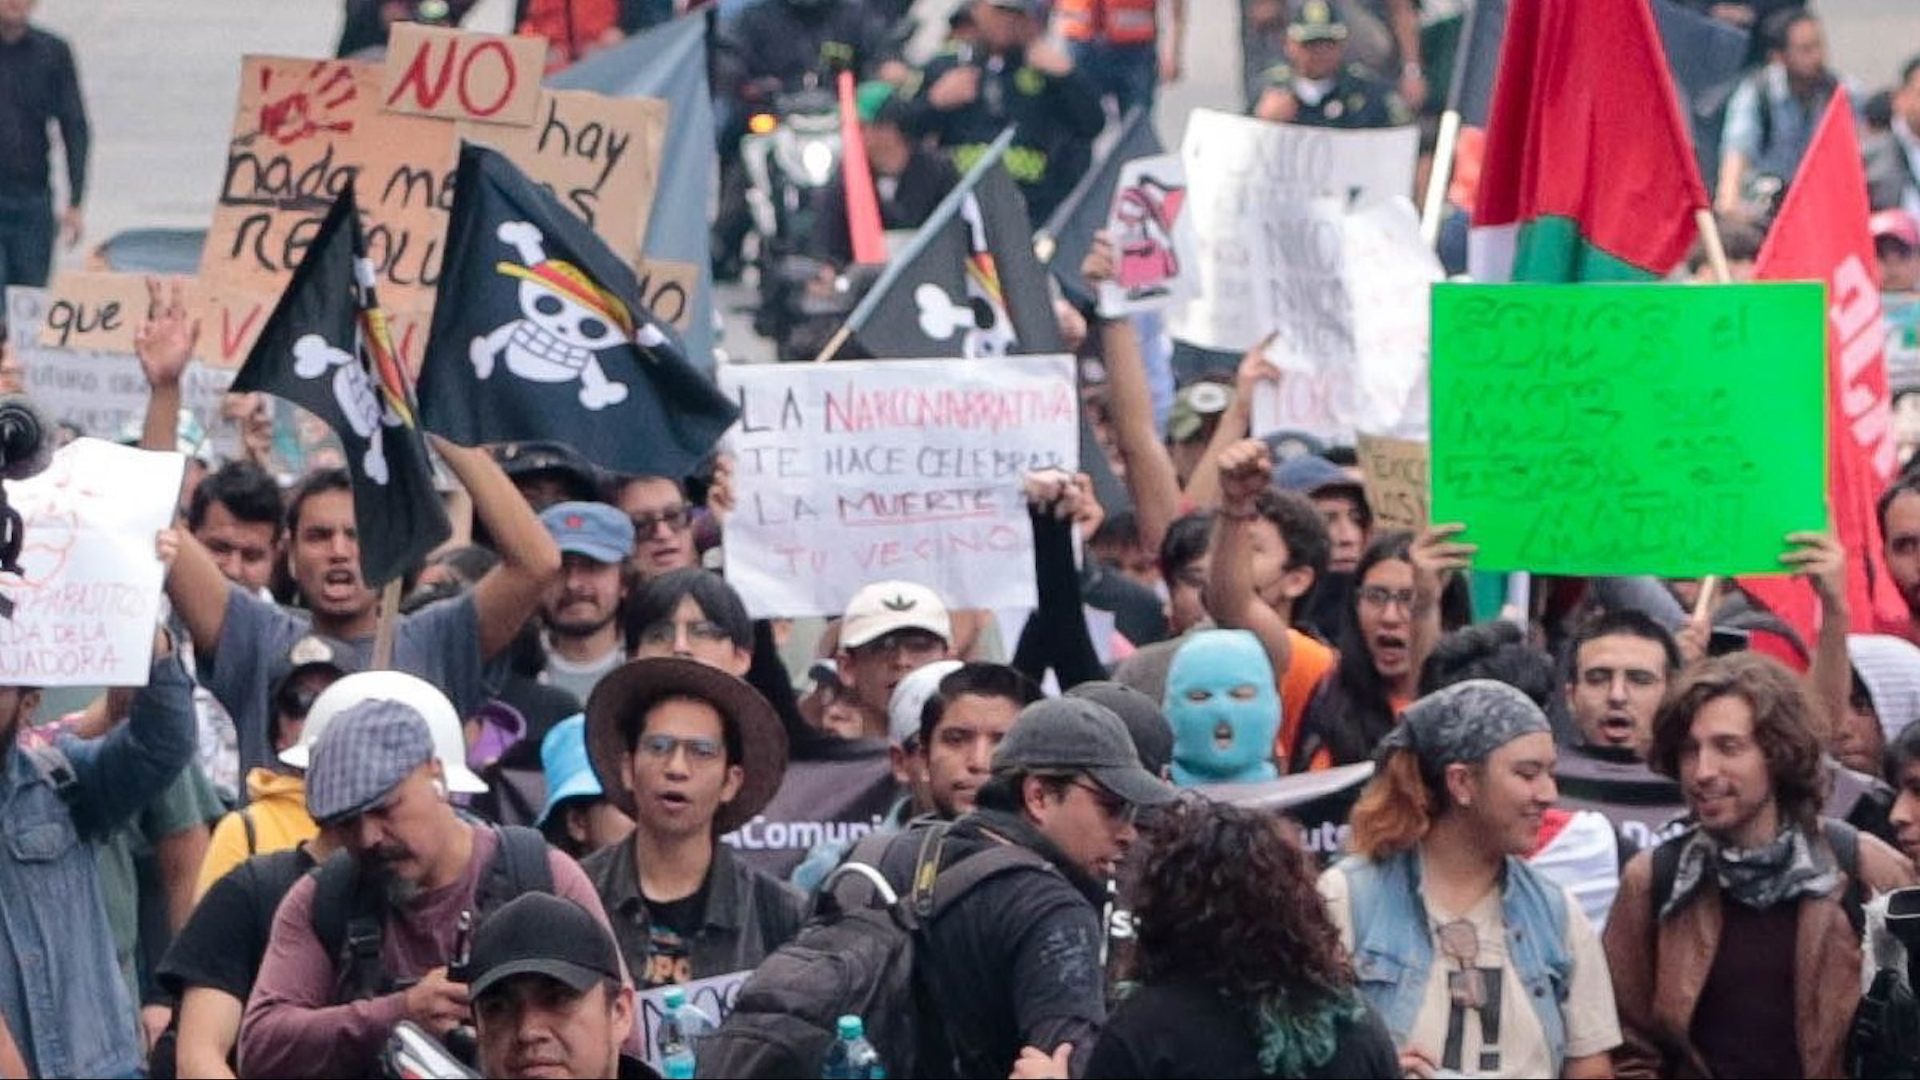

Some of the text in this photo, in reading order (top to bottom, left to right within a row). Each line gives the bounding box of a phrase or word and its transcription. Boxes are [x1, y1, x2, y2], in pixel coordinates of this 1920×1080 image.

[387, 39, 517, 116] NO
[537, 98, 630, 187] hay
[48, 299, 123, 346] que
[738, 384, 804, 433] LA
[742, 447, 807, 477] TE
[825, 446, 906, 477] HACE
[752, 489, 819, 527] LA
[837, 487, 999, 521] MUERTE
[771, 524, 1020, 577] TU VECINO
